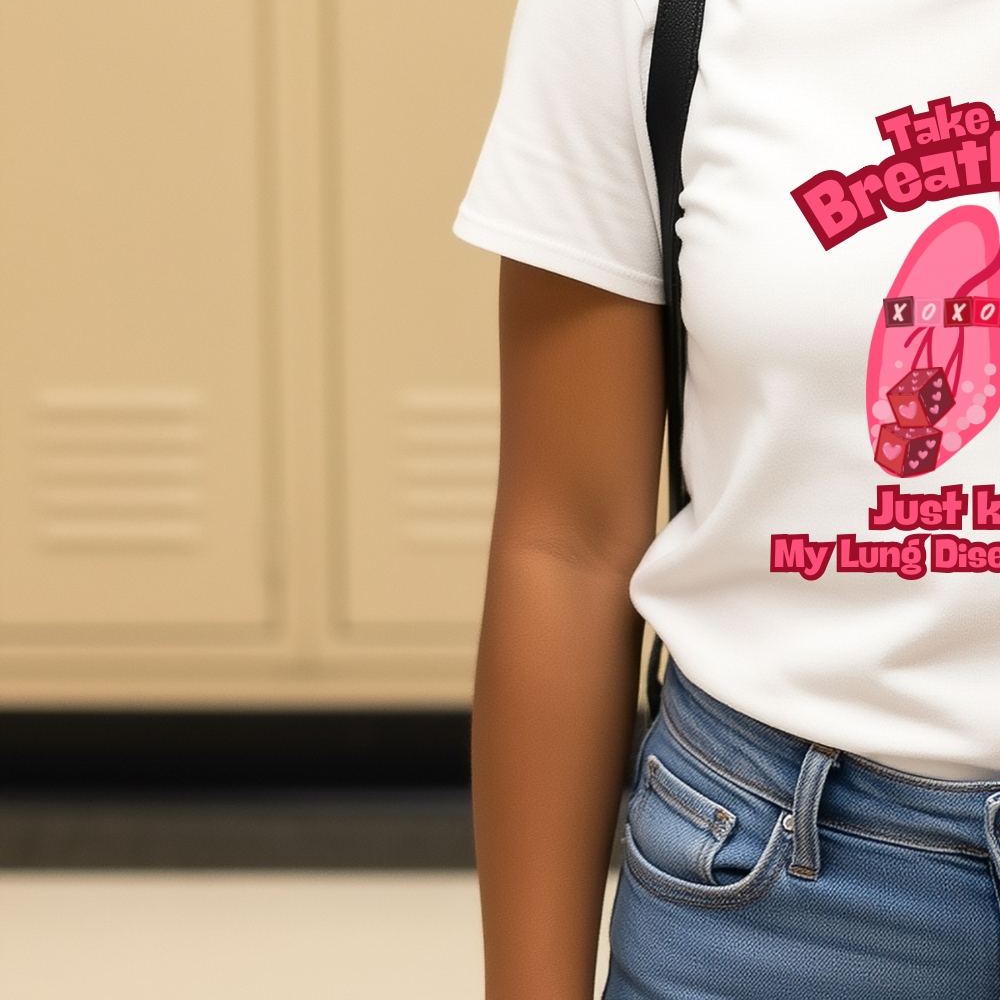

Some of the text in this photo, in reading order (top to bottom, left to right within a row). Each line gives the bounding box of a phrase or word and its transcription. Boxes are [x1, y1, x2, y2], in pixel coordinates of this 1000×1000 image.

[881, 102, 992, 153] Take
[871, 488, 964, 528] Just
[772, 537, 832, 578] My
[838, 537, 925, 577] Lung
